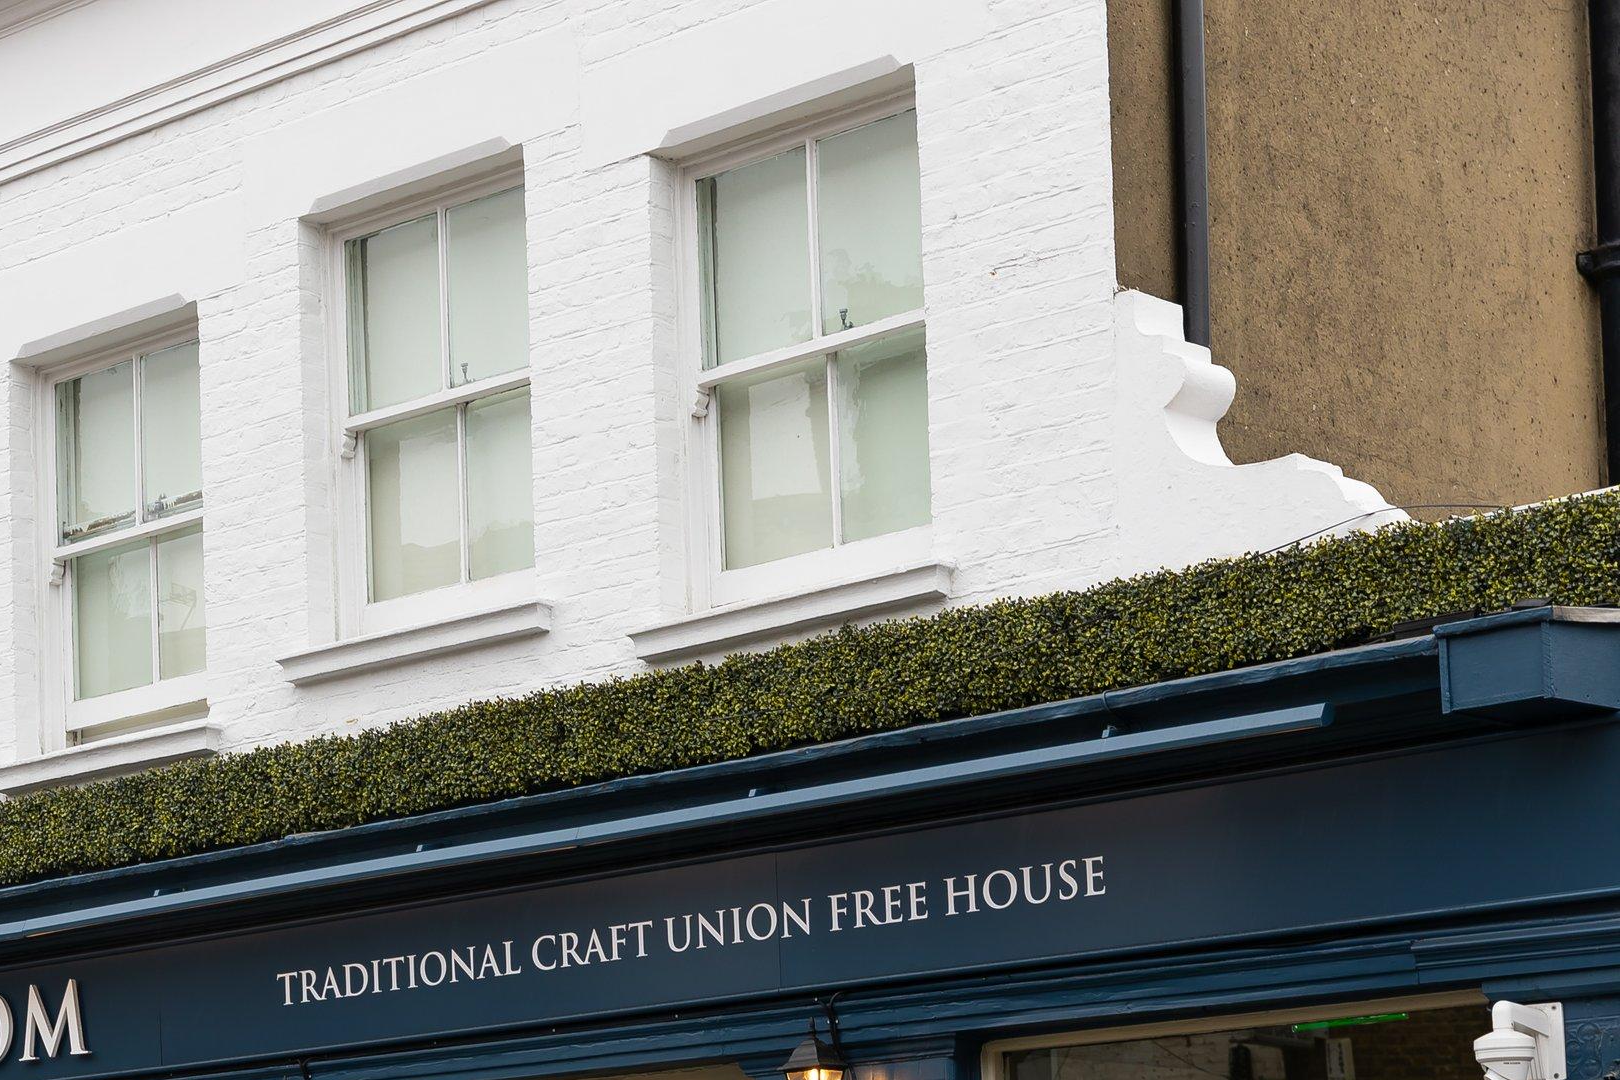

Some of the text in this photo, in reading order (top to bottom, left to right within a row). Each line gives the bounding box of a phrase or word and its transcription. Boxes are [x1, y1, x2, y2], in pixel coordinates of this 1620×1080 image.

[276, 855, 1106, 1007] TRADITIONAL CRAFT UNION FREE HOUSE
